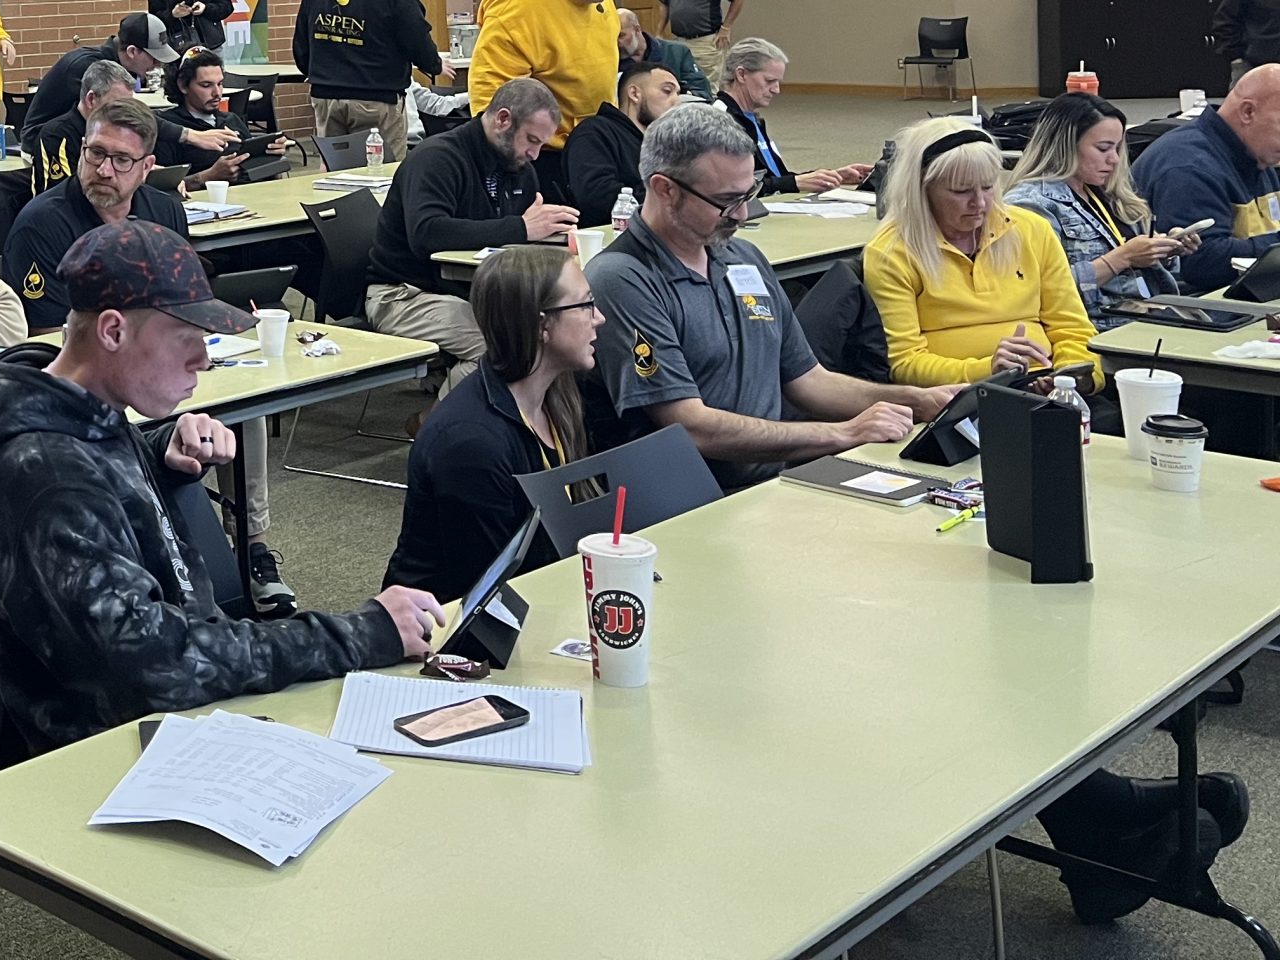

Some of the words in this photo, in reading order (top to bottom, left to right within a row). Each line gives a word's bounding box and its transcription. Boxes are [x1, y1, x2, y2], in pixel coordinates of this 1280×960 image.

[315, 13, 365, 31] ASPEN
[594, 593, 617, 612] JIMMY
[603, 605, 634, 635] JJ
